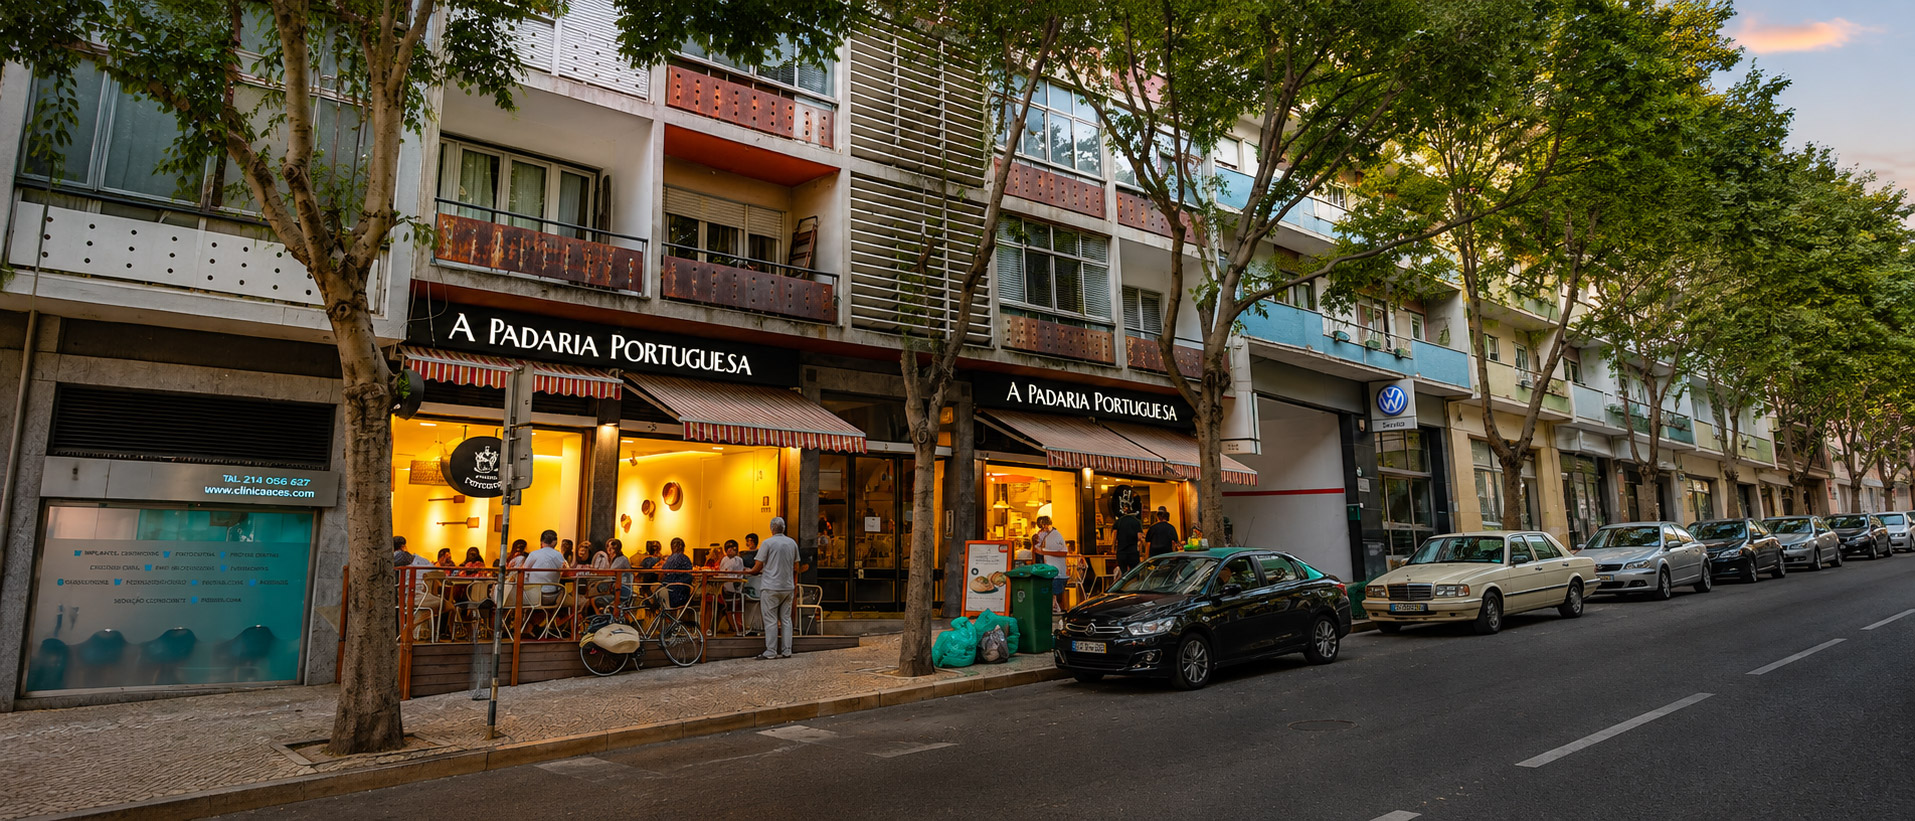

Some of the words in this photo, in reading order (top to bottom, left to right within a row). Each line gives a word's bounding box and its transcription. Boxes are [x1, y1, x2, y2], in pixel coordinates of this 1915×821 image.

[448, 312, 476, 342] A
[489, 318, 599, 357] PADARIA
[610, 334, 752, 376] PORTUGUESA
[1006, 381, 1022, 403] A
[1028, 384, 1090, 410] PADARIA
[1094, 391, 1178, 421] PORTUGUESA
[243, 476, 263, 484] 214
